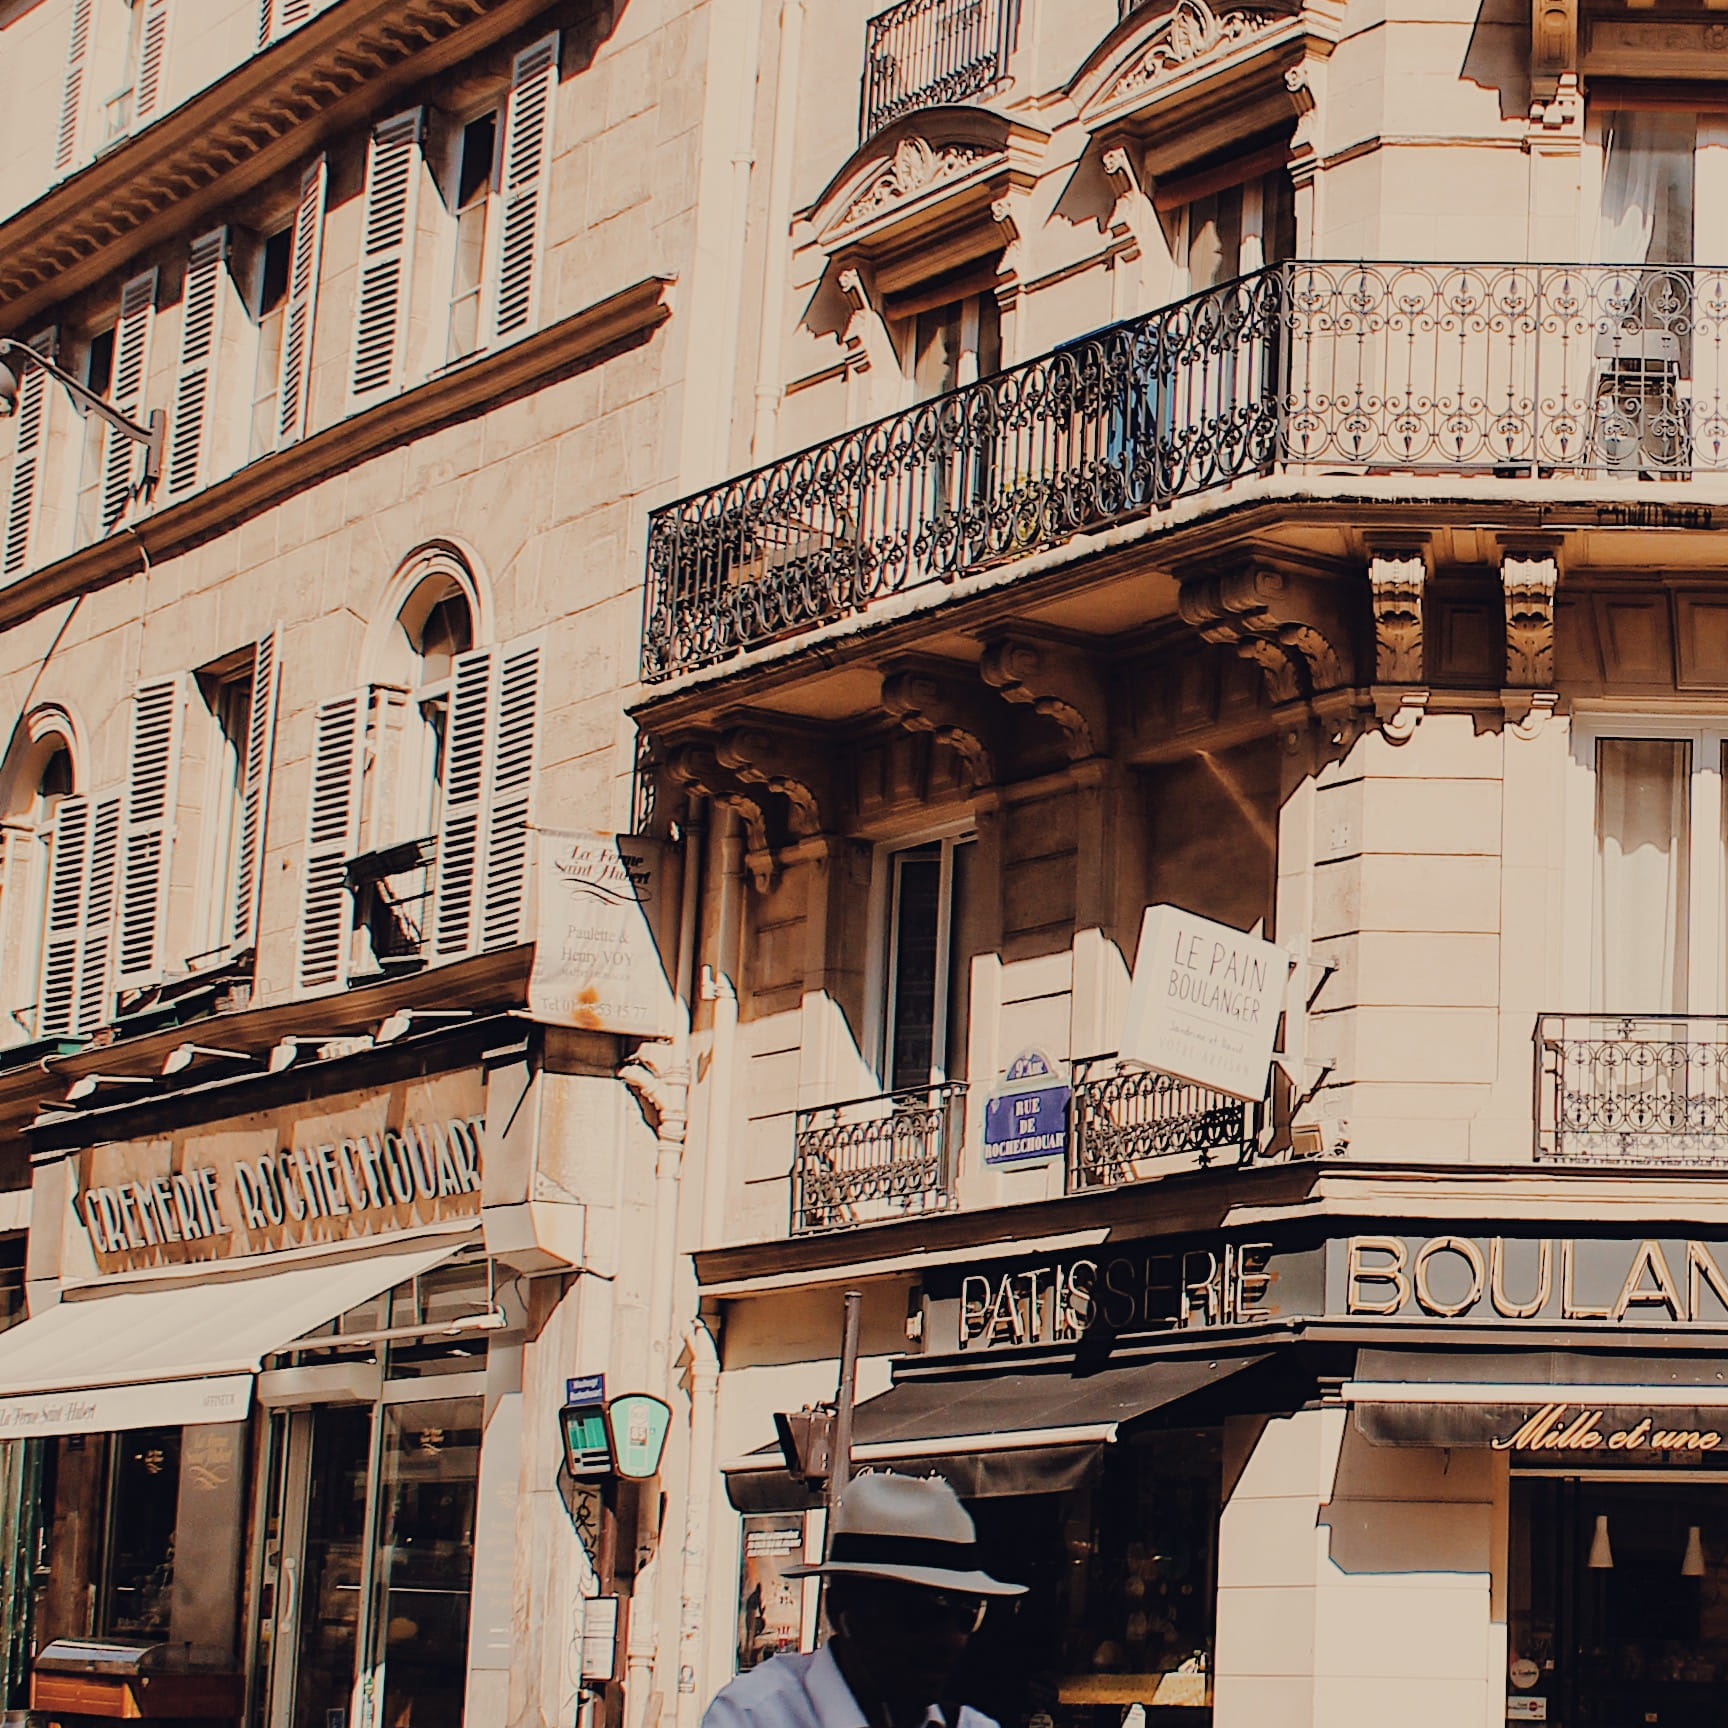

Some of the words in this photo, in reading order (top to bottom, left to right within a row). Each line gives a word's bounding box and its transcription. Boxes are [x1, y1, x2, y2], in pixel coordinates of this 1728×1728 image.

[571, 845, 590, 860] La
[599, 848, 644, 867] Ferme
[554, 860, 593, 876] Saint
[561, 946, 598, 966] Henry
[602, 950, 635, 967] VOY
[1174, 930, 1203, 971] LE
[1209, 941, 1267, 993] PAIN
[1167, 968, 1261, 1024] BOULANGER
[1015, 1097, 1041, 1116] RUE
[1019, 1118, 1037, 1134] DE
[959, 1242, 1275, 1349] PATISSERIE
[1490, 1403, 1602, 1452] Mille
[1606, 1416, 1652, 1450] et
[1649, 1428, 1722, 1450] une
